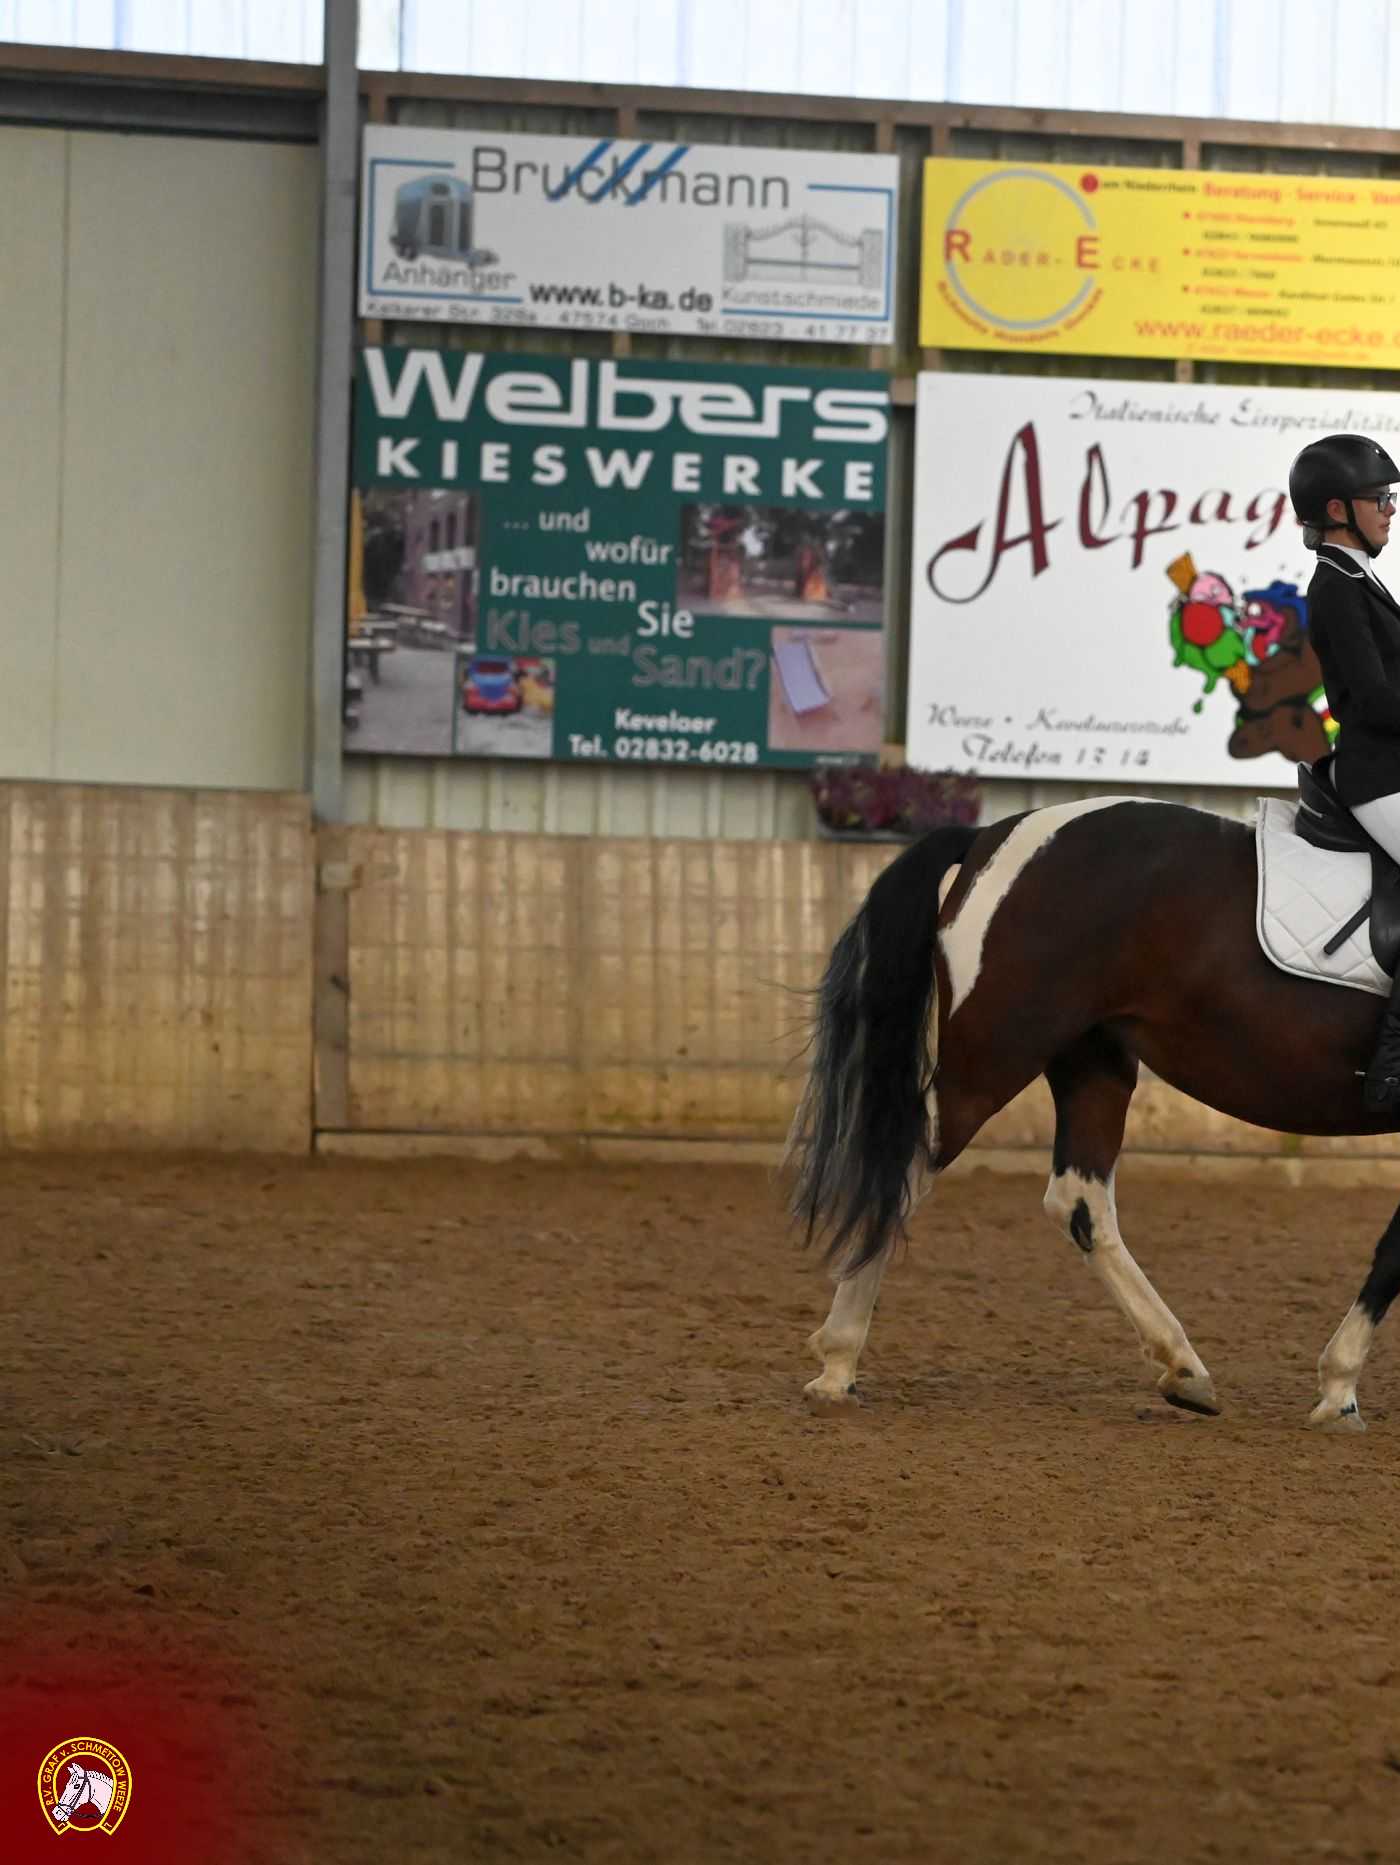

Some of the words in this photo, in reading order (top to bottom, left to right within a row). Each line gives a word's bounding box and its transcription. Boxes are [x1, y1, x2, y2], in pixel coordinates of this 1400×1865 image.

[383, 261, 518, 294] Anhänger
[529, 281, 713, 313] www.b-ka.de
[364, 347, 889, 445] Welbers
[1068, 390, 1221, 426] Italienische
[376, 436, 875, 501] KIESWERKE
[539, 507, 591, 533] und
[927, 421, 1303, 604] Alpag
[585, 535, 671, 565] wofür
[490, 567, 637, 602] brauchen
[486, 609, 582, 655] Kies
[588, 632, 632, 656] und
[637, 600, 695, 639] Sie
[632, 646, 767, 691] Sand?
[569, 734, 606, 759] Tel.
[615, 736, 759, 765] 02832-6028
[961, 733, 1063, 771] Telefon
